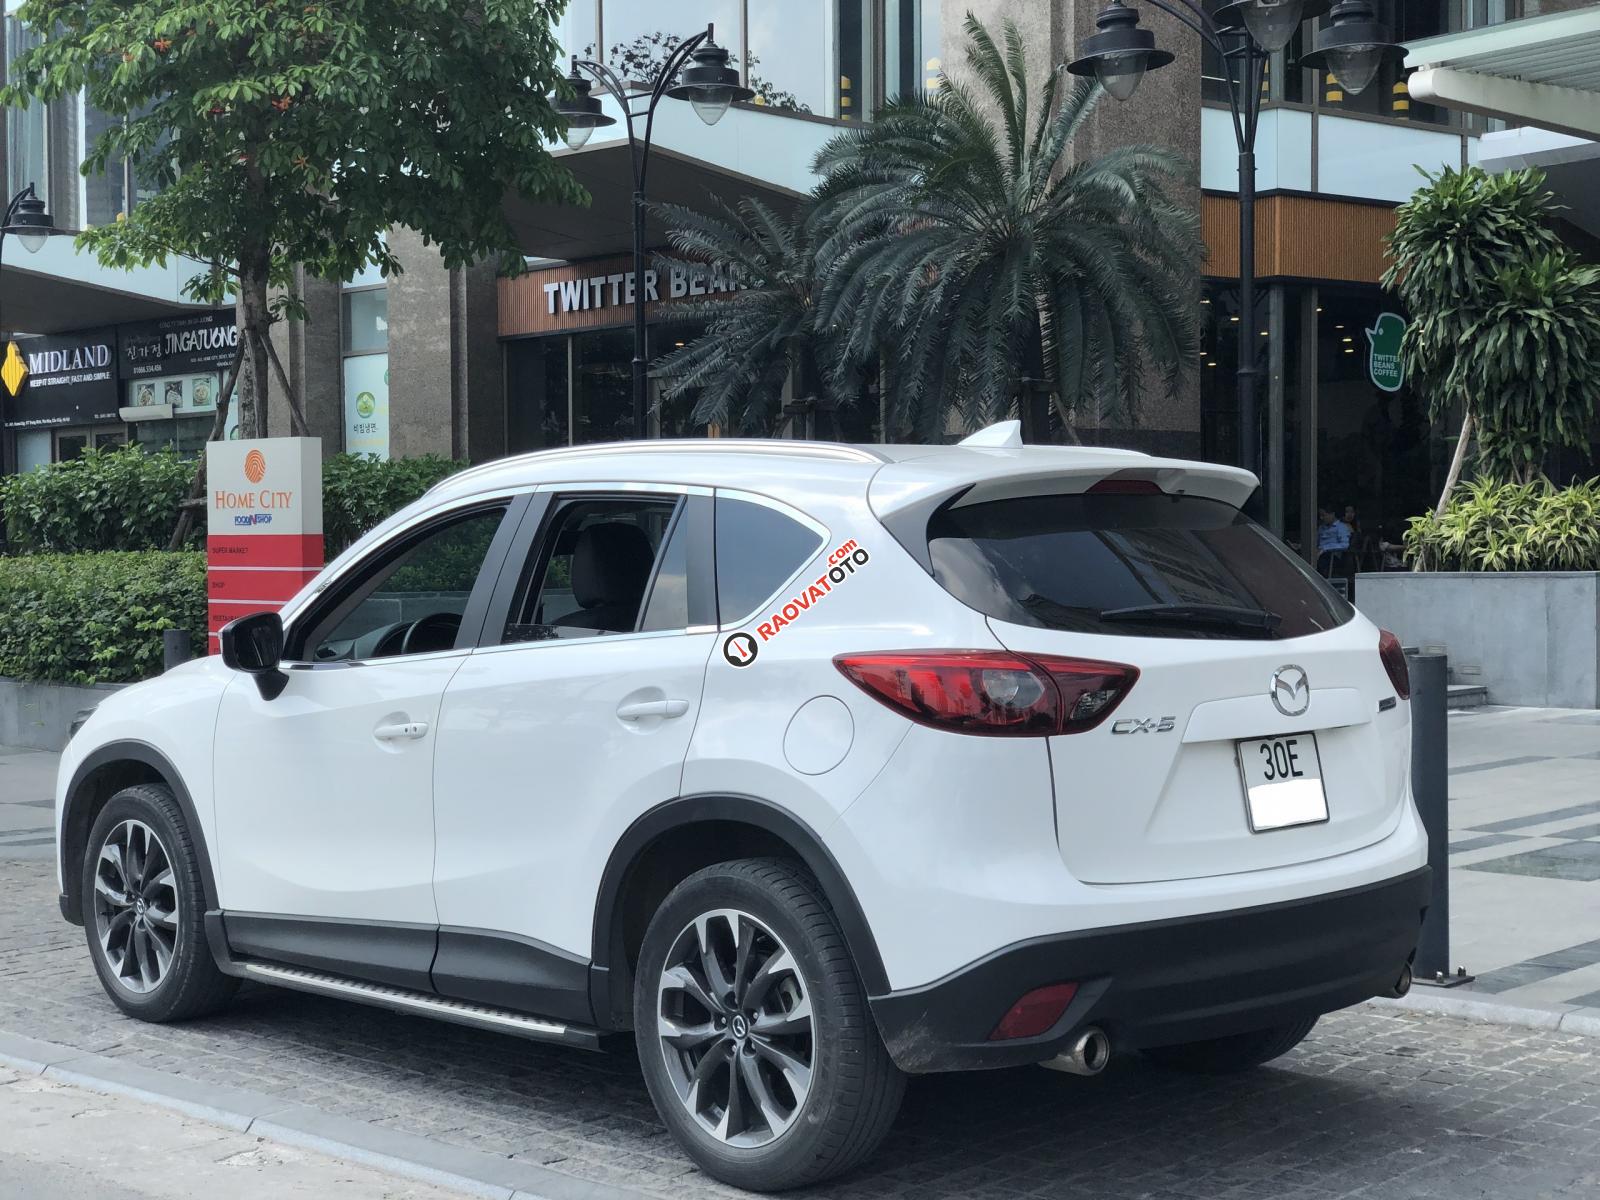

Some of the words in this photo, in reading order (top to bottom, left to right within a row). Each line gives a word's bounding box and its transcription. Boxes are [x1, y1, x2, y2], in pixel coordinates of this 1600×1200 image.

[543, 269, 659, 315] TWITTER
[670, 264, 748, 298] BEA
[28, 344, 111, 375] MIDLAND
[1373, 353, 1400, 363] TWITTE
[1373, 360, 1395, 370] BEANS
[1373, 368, 1398, 377] COFFEE
[215, 490, 256, 510] HOME
[260, 489, 292, 510] CITY
[1110, 715, 1177, 735] CX-5
[1259, 739, 1304, 781] 30E
